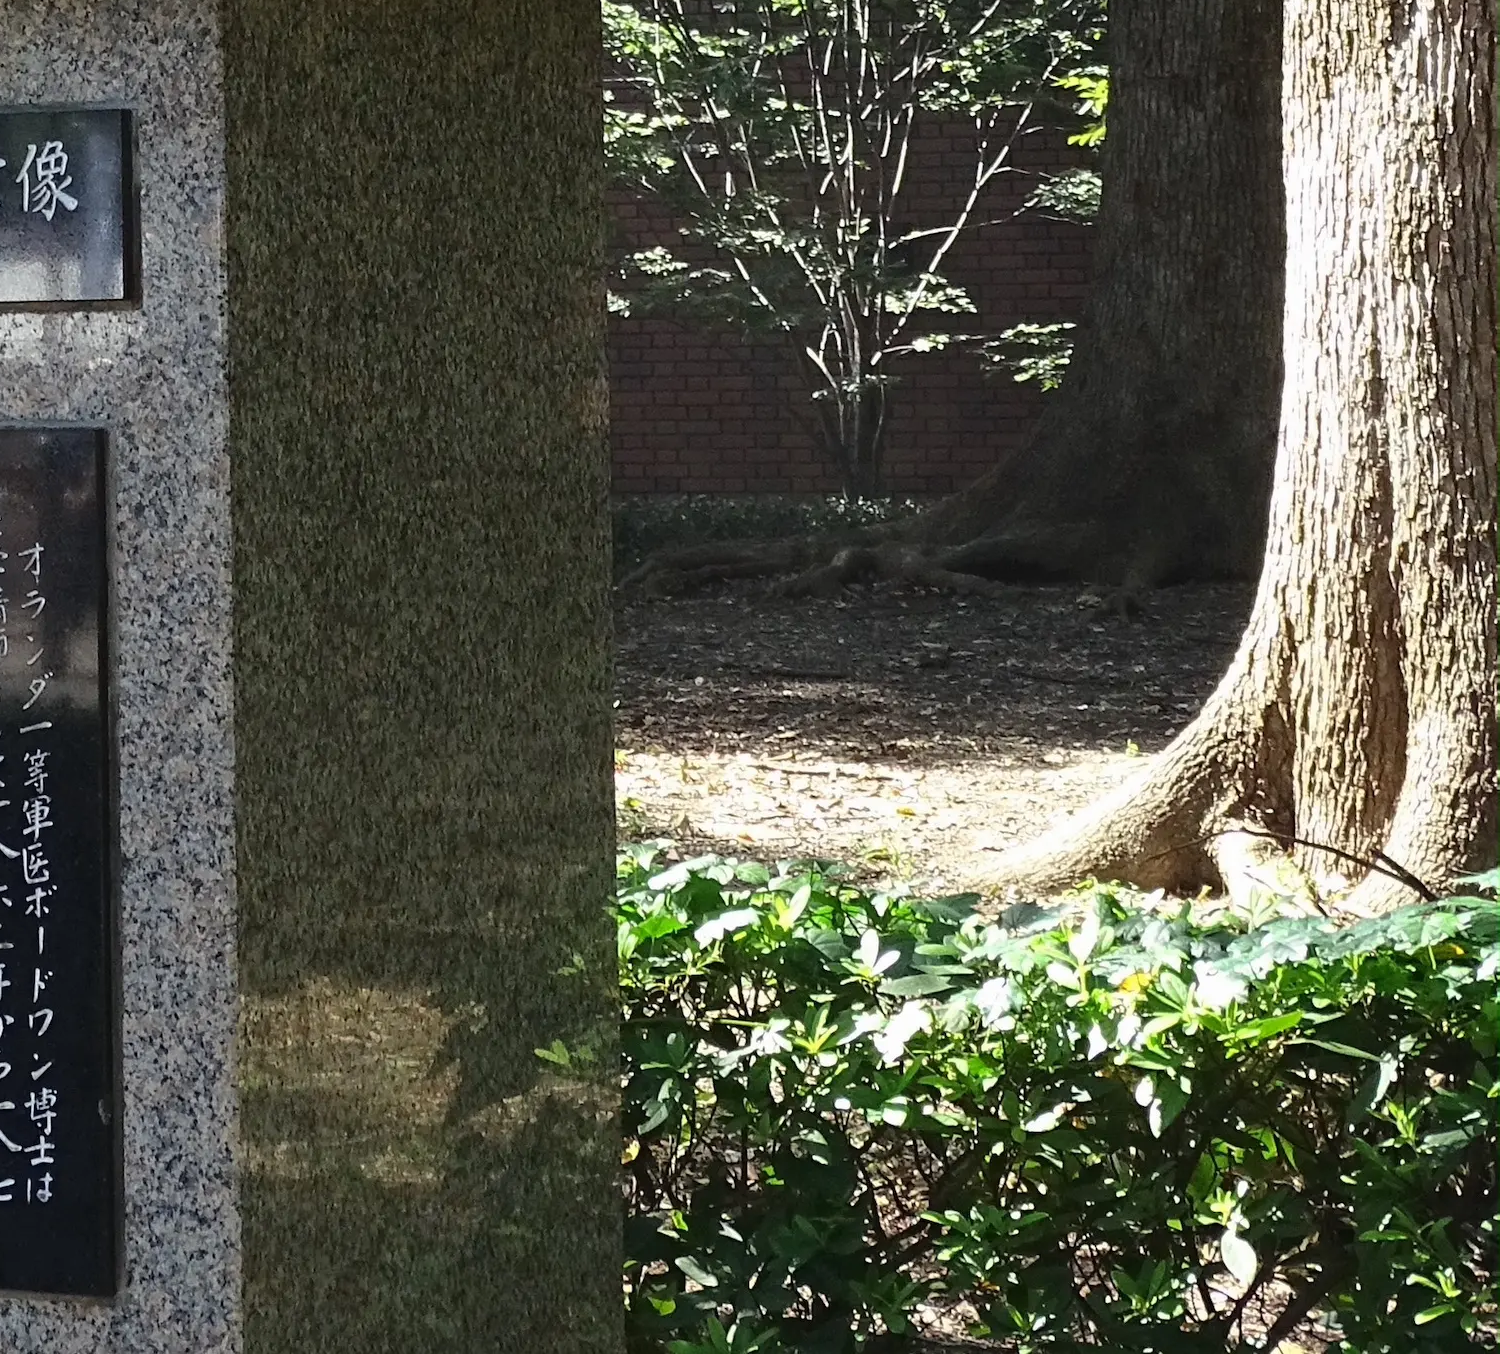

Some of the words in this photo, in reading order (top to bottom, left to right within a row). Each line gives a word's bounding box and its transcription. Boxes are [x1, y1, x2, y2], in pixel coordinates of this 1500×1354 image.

[18, 542, 59, 1204] オランダ一等軍医ボードワン博士は
